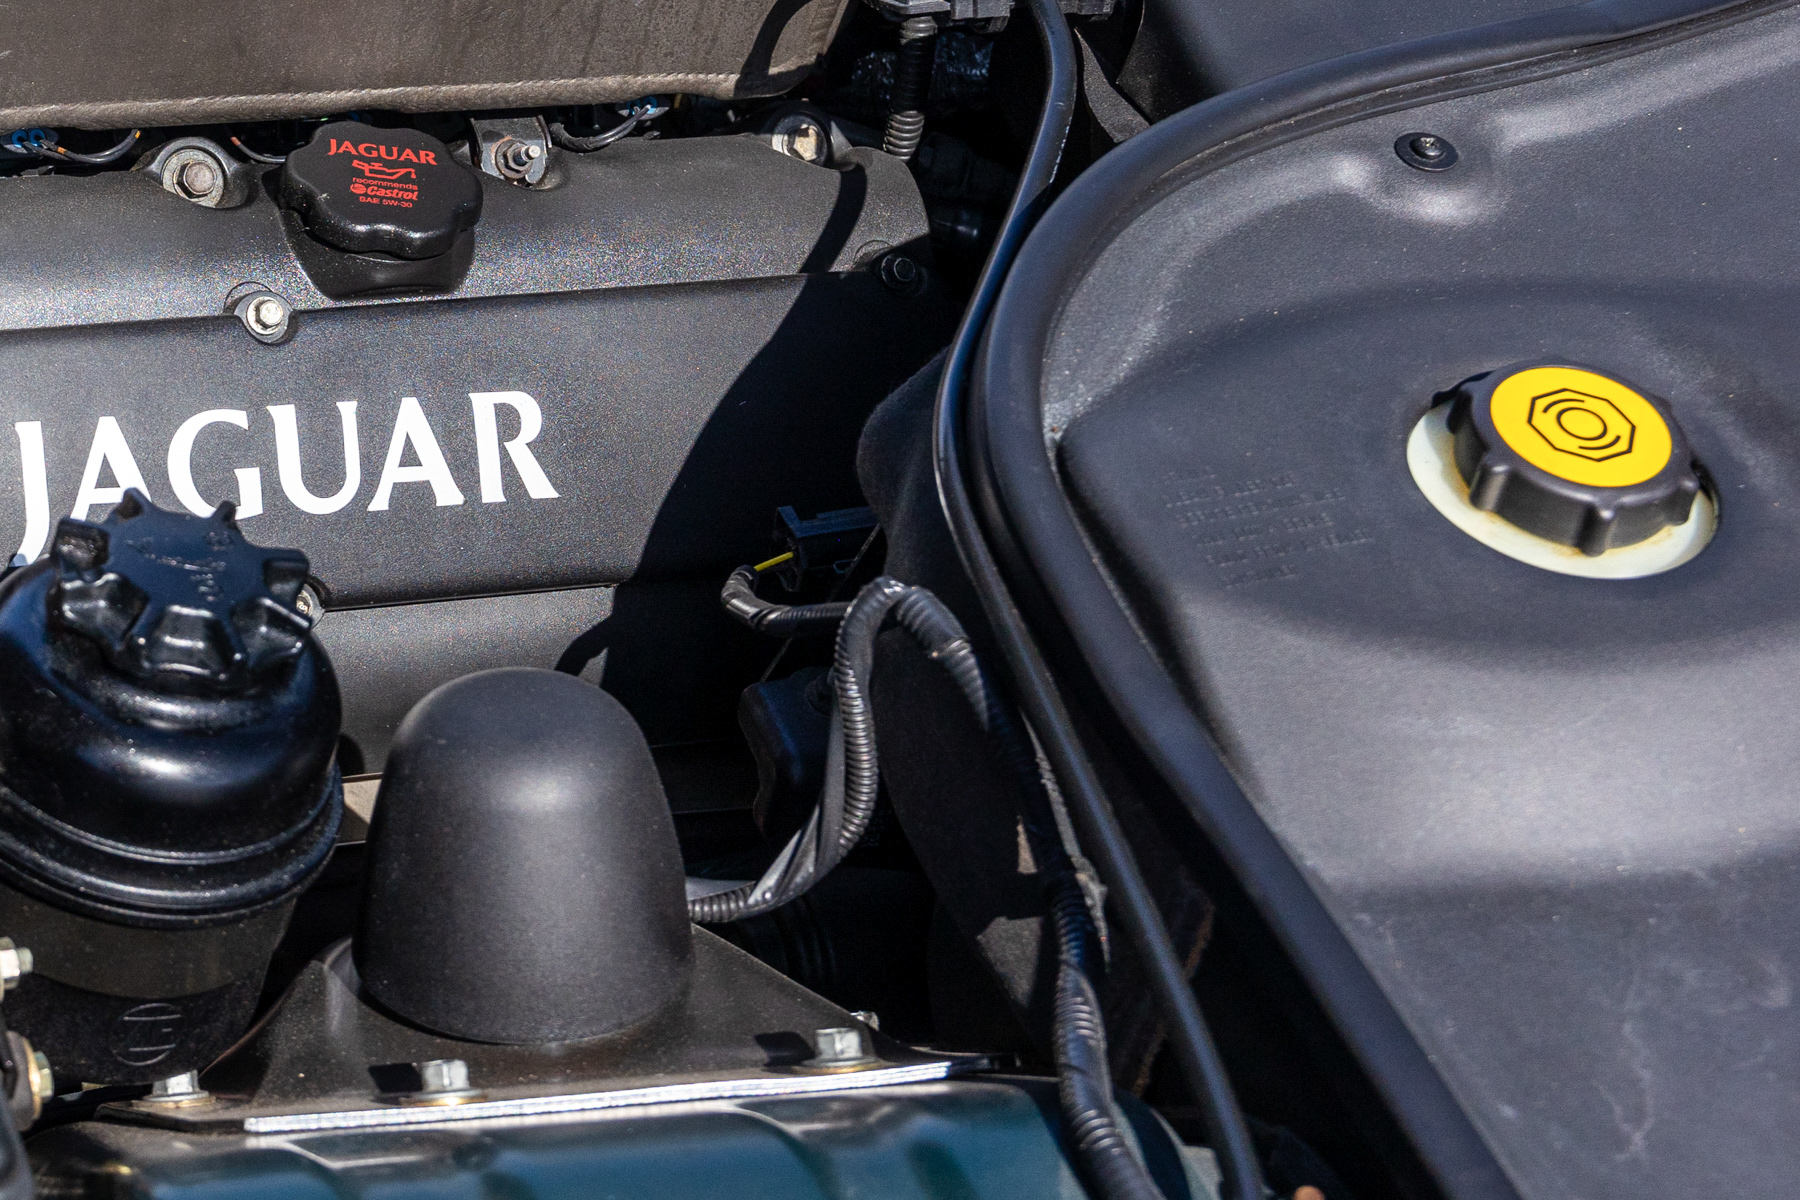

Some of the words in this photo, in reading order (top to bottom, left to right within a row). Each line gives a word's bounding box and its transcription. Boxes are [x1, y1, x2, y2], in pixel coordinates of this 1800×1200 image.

[328, 138, 437, 166] JAGUAR
[352, 177, 419, 191] recommends
[367, 185, 419, 201] Castrol
[359, 196, 380, 205] SAE
[382, 197, 413, 208] 5W-30
[11, 390, 559, 568] JAGUAR
